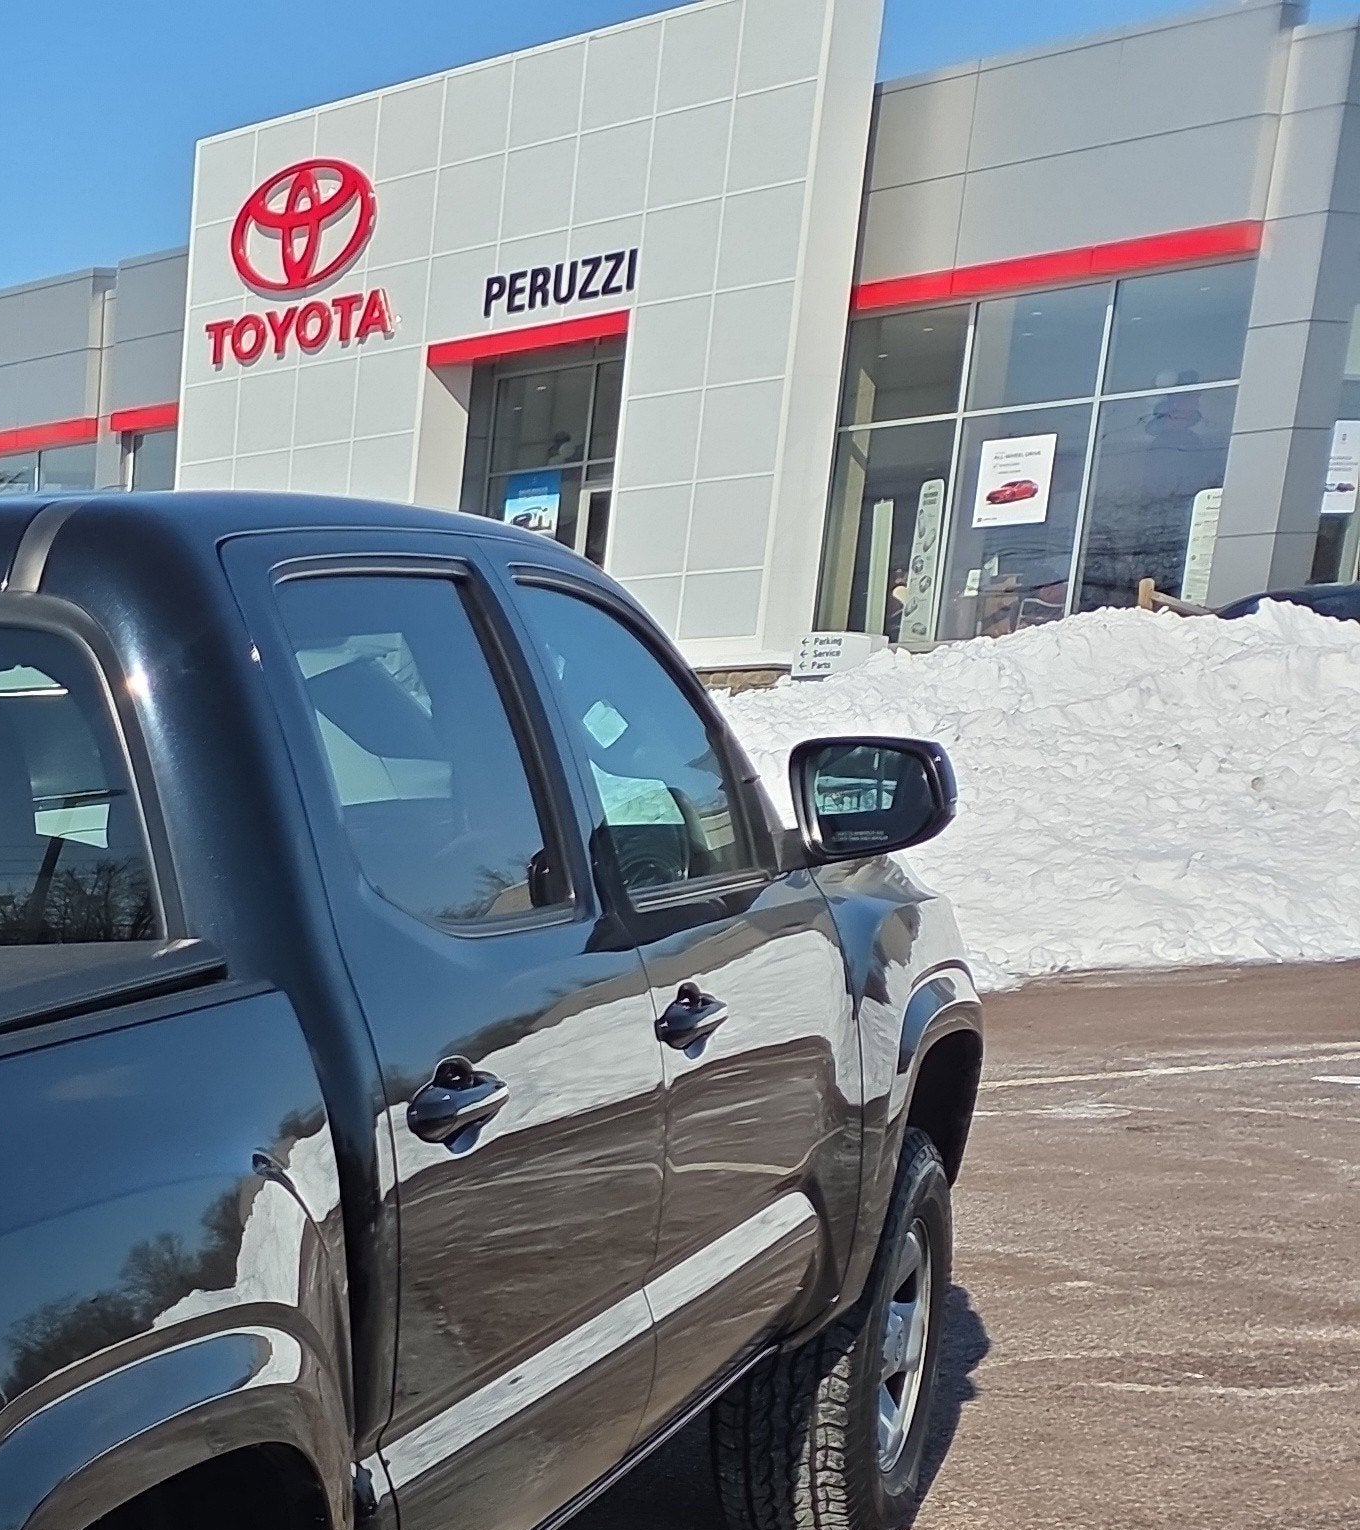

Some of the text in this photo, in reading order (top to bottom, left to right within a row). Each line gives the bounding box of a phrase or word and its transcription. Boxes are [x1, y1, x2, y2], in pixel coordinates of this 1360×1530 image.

[482, 248, 639, 318] PERUZZI
[206, 288, 394, 367] TOYOTA
[813, 636, 843, 646] Parking
[813, 649, 841, 658] Service
[811, 660, 832, 669] Parts
